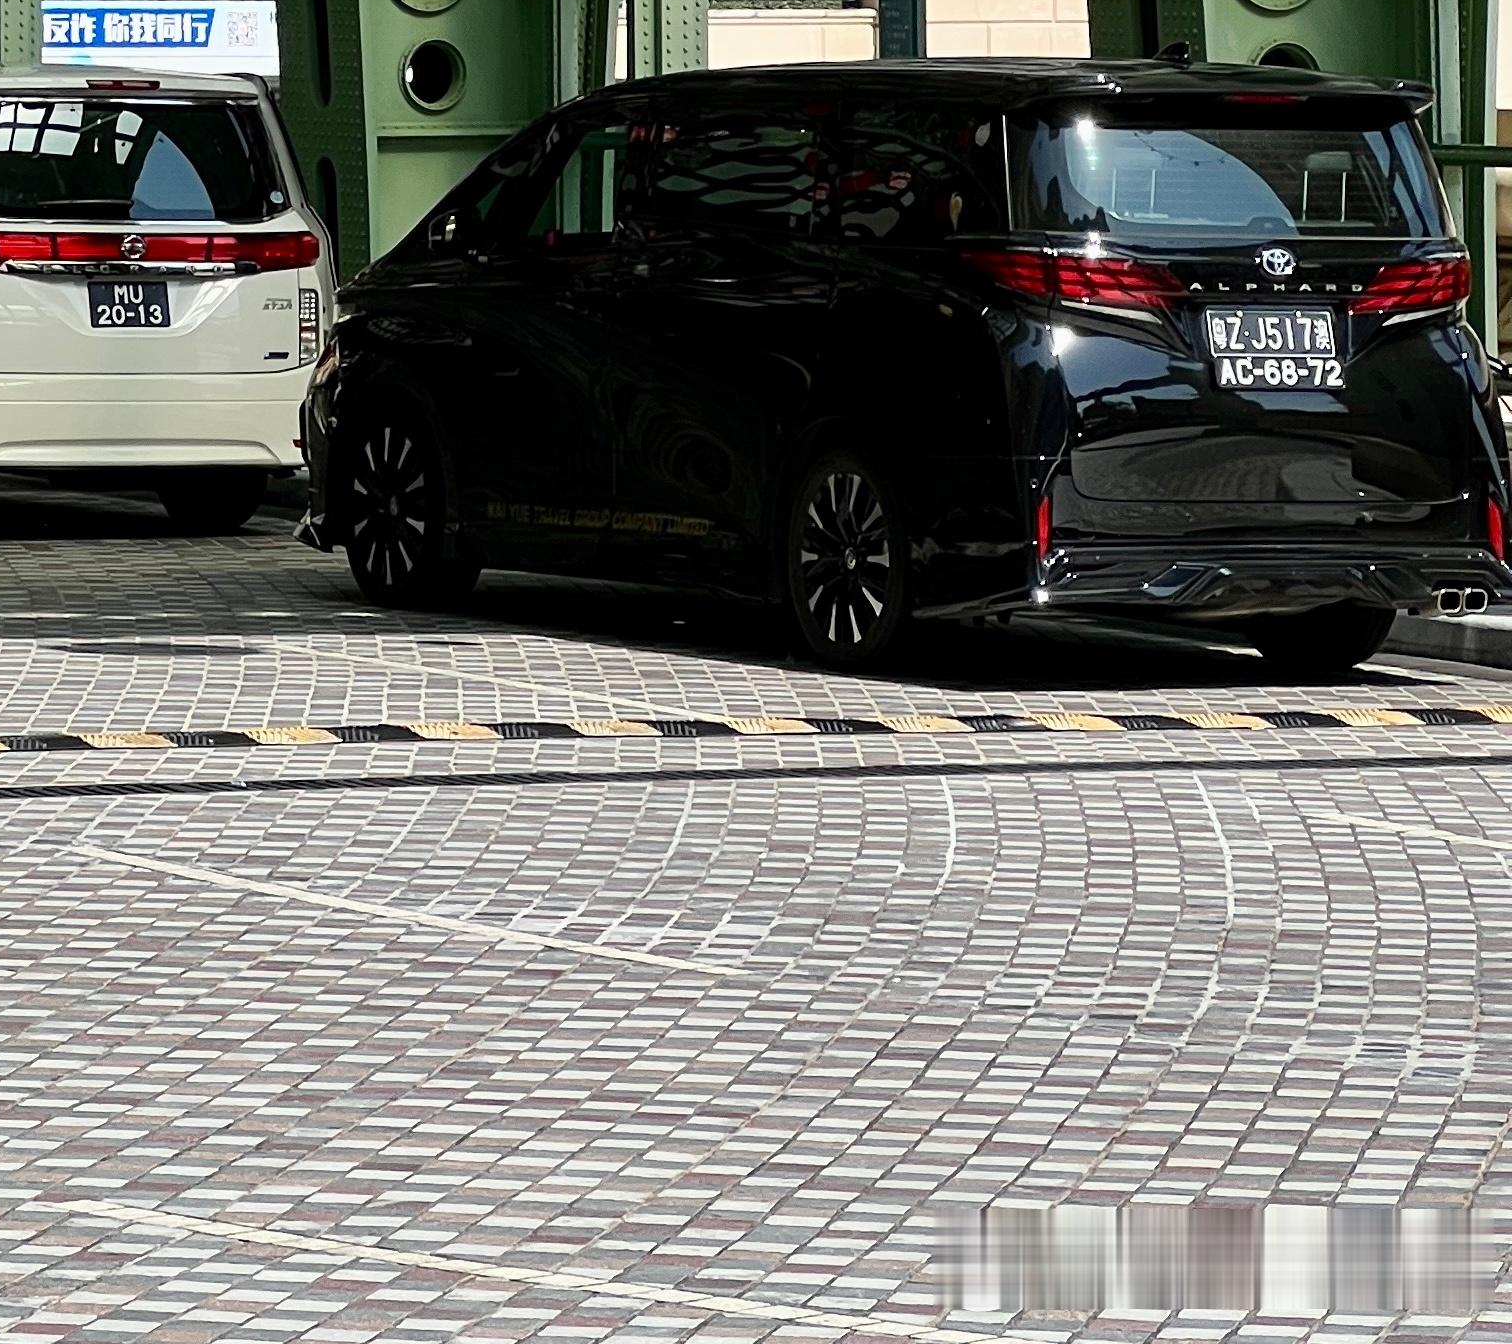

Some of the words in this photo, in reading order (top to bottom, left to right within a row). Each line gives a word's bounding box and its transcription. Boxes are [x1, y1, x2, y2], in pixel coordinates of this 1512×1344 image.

[43, 13, 96, 43] 反诈
[103, 13, 209, 43] 你我同行
[114, 284, 143, 304] MU
[1190, 282, 1363, 292] ALPHARD
[97, 305, 164, 325] 20-13
[1220, 358, 1344, 387] AC-68-72
[534, 506, 571, 526] TRAVEL
